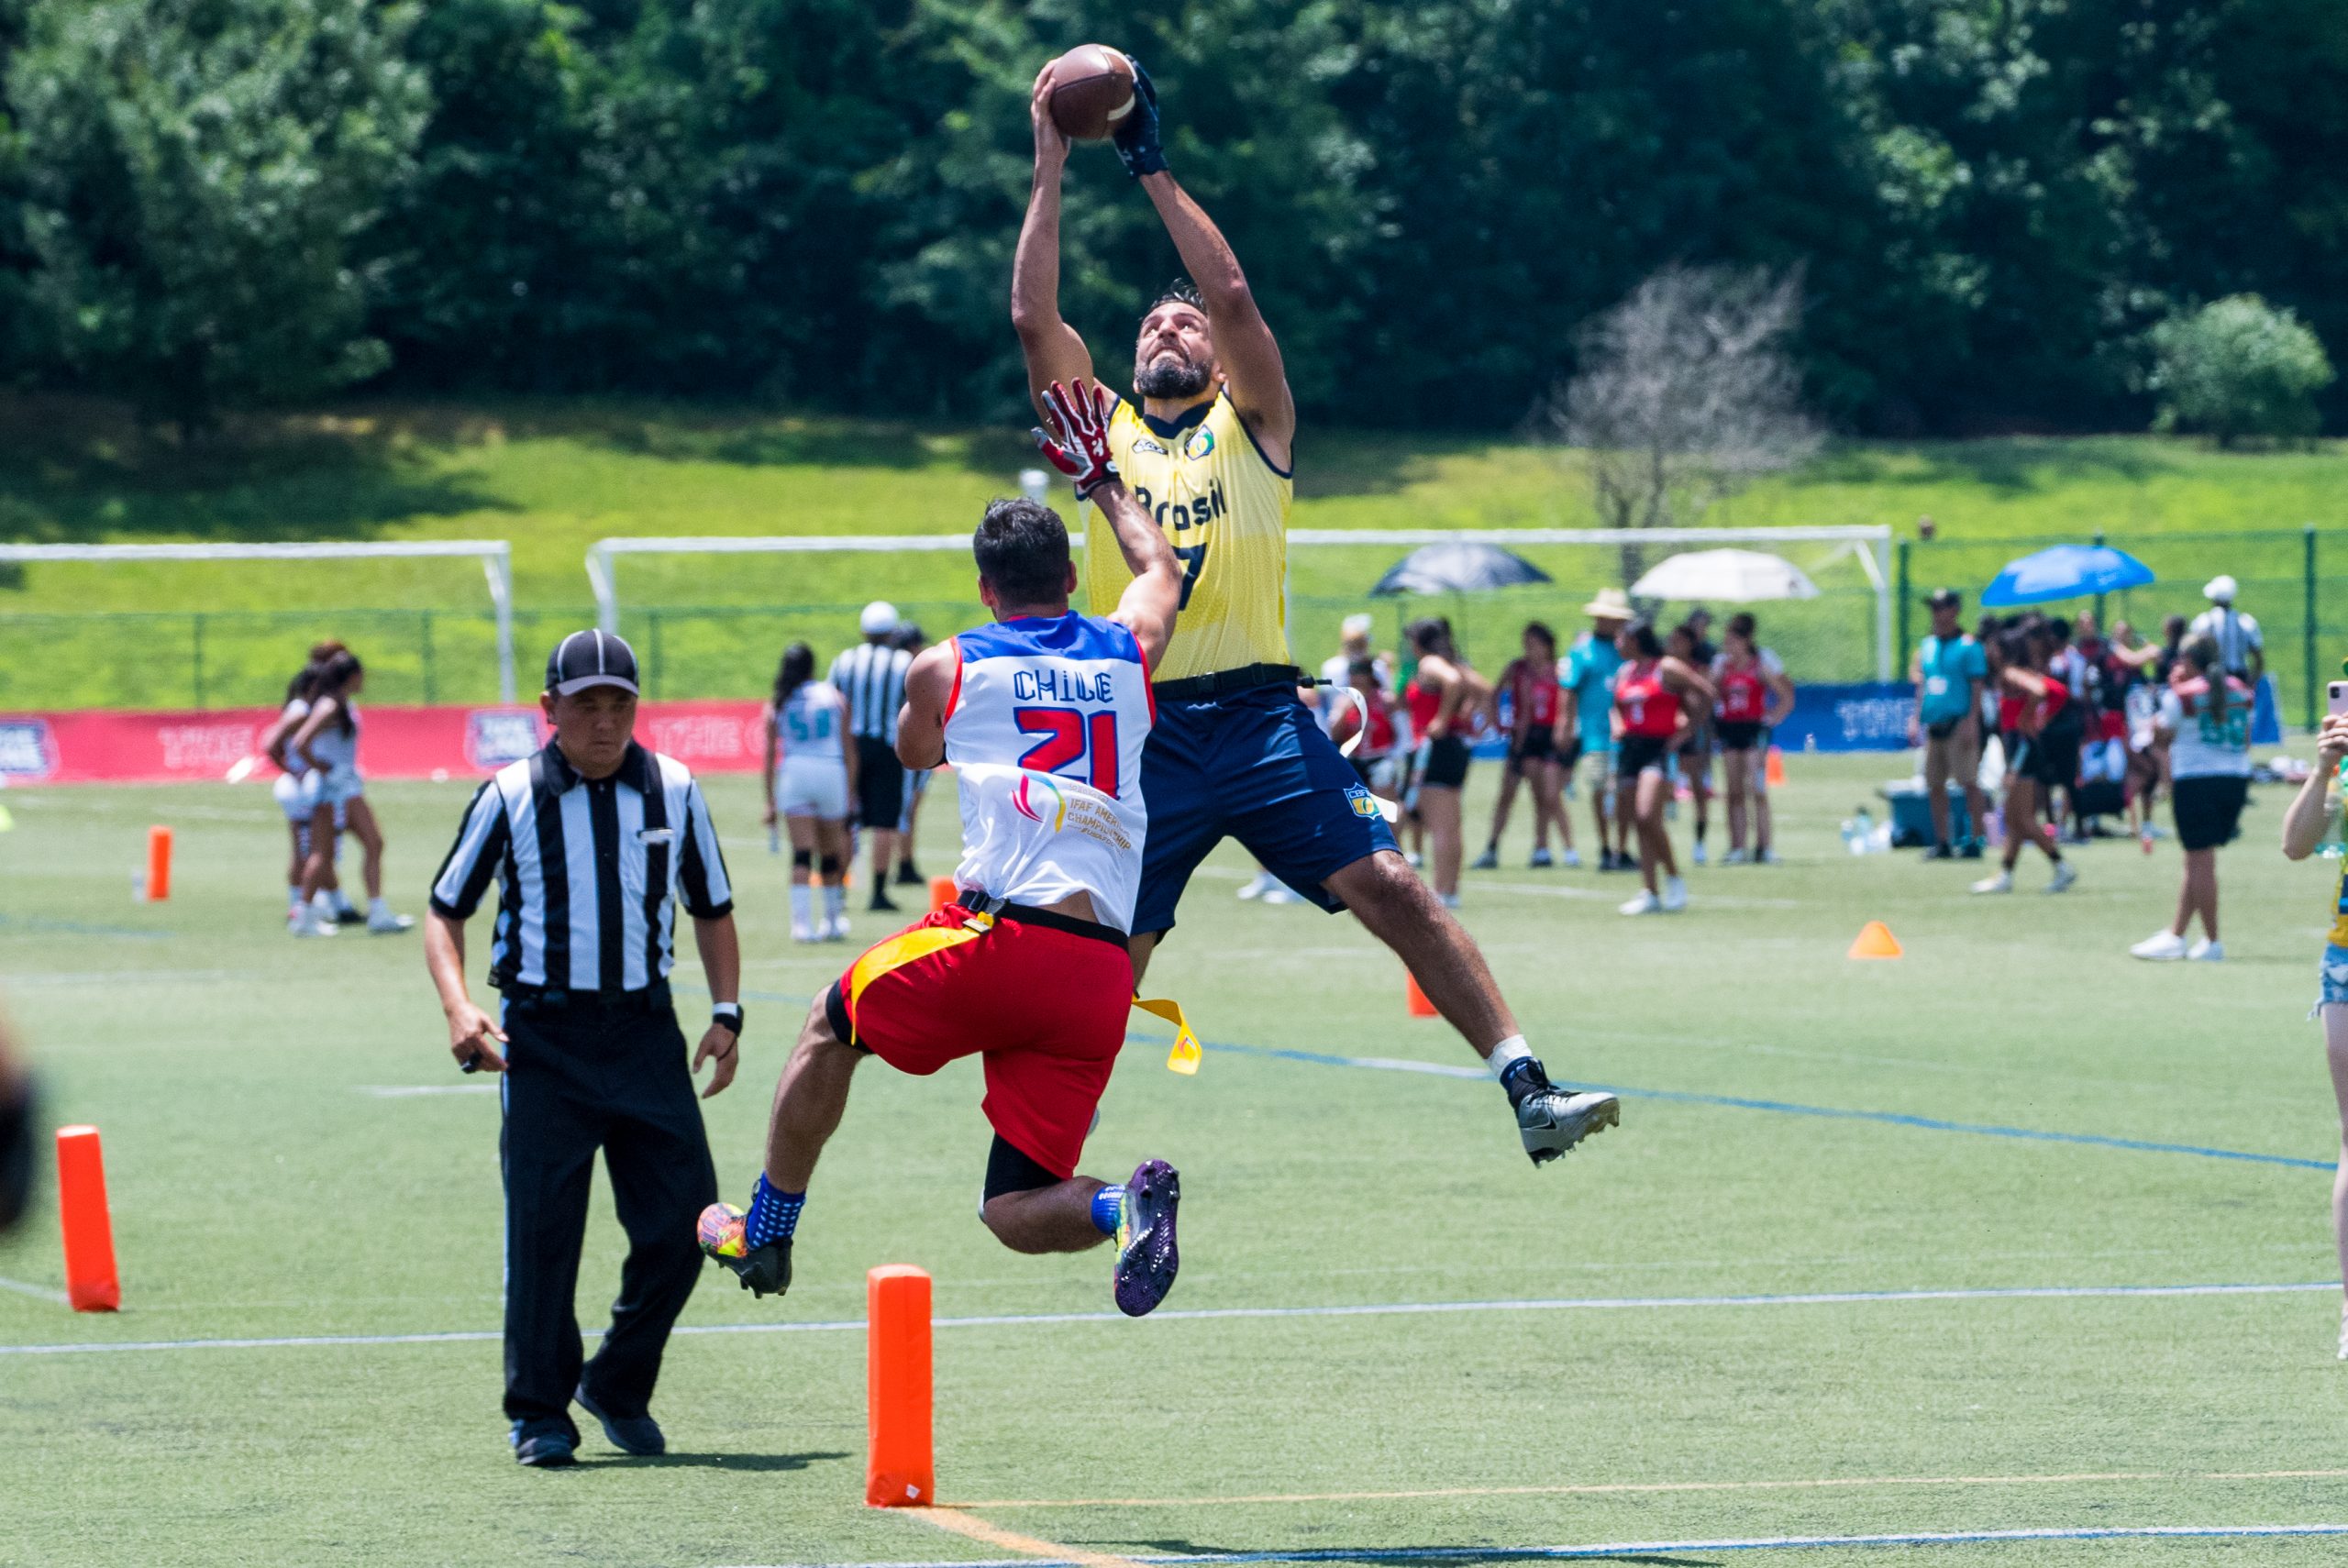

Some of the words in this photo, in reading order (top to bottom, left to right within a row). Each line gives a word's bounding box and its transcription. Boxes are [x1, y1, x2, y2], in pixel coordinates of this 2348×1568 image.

[1171, 542, 1207, 611] 7
[1013, 706, 1121, 801] 21
[1067, 812, 1132, 849] CHAMPIHIP
[1069, 798, 1093, 812] IFAF
